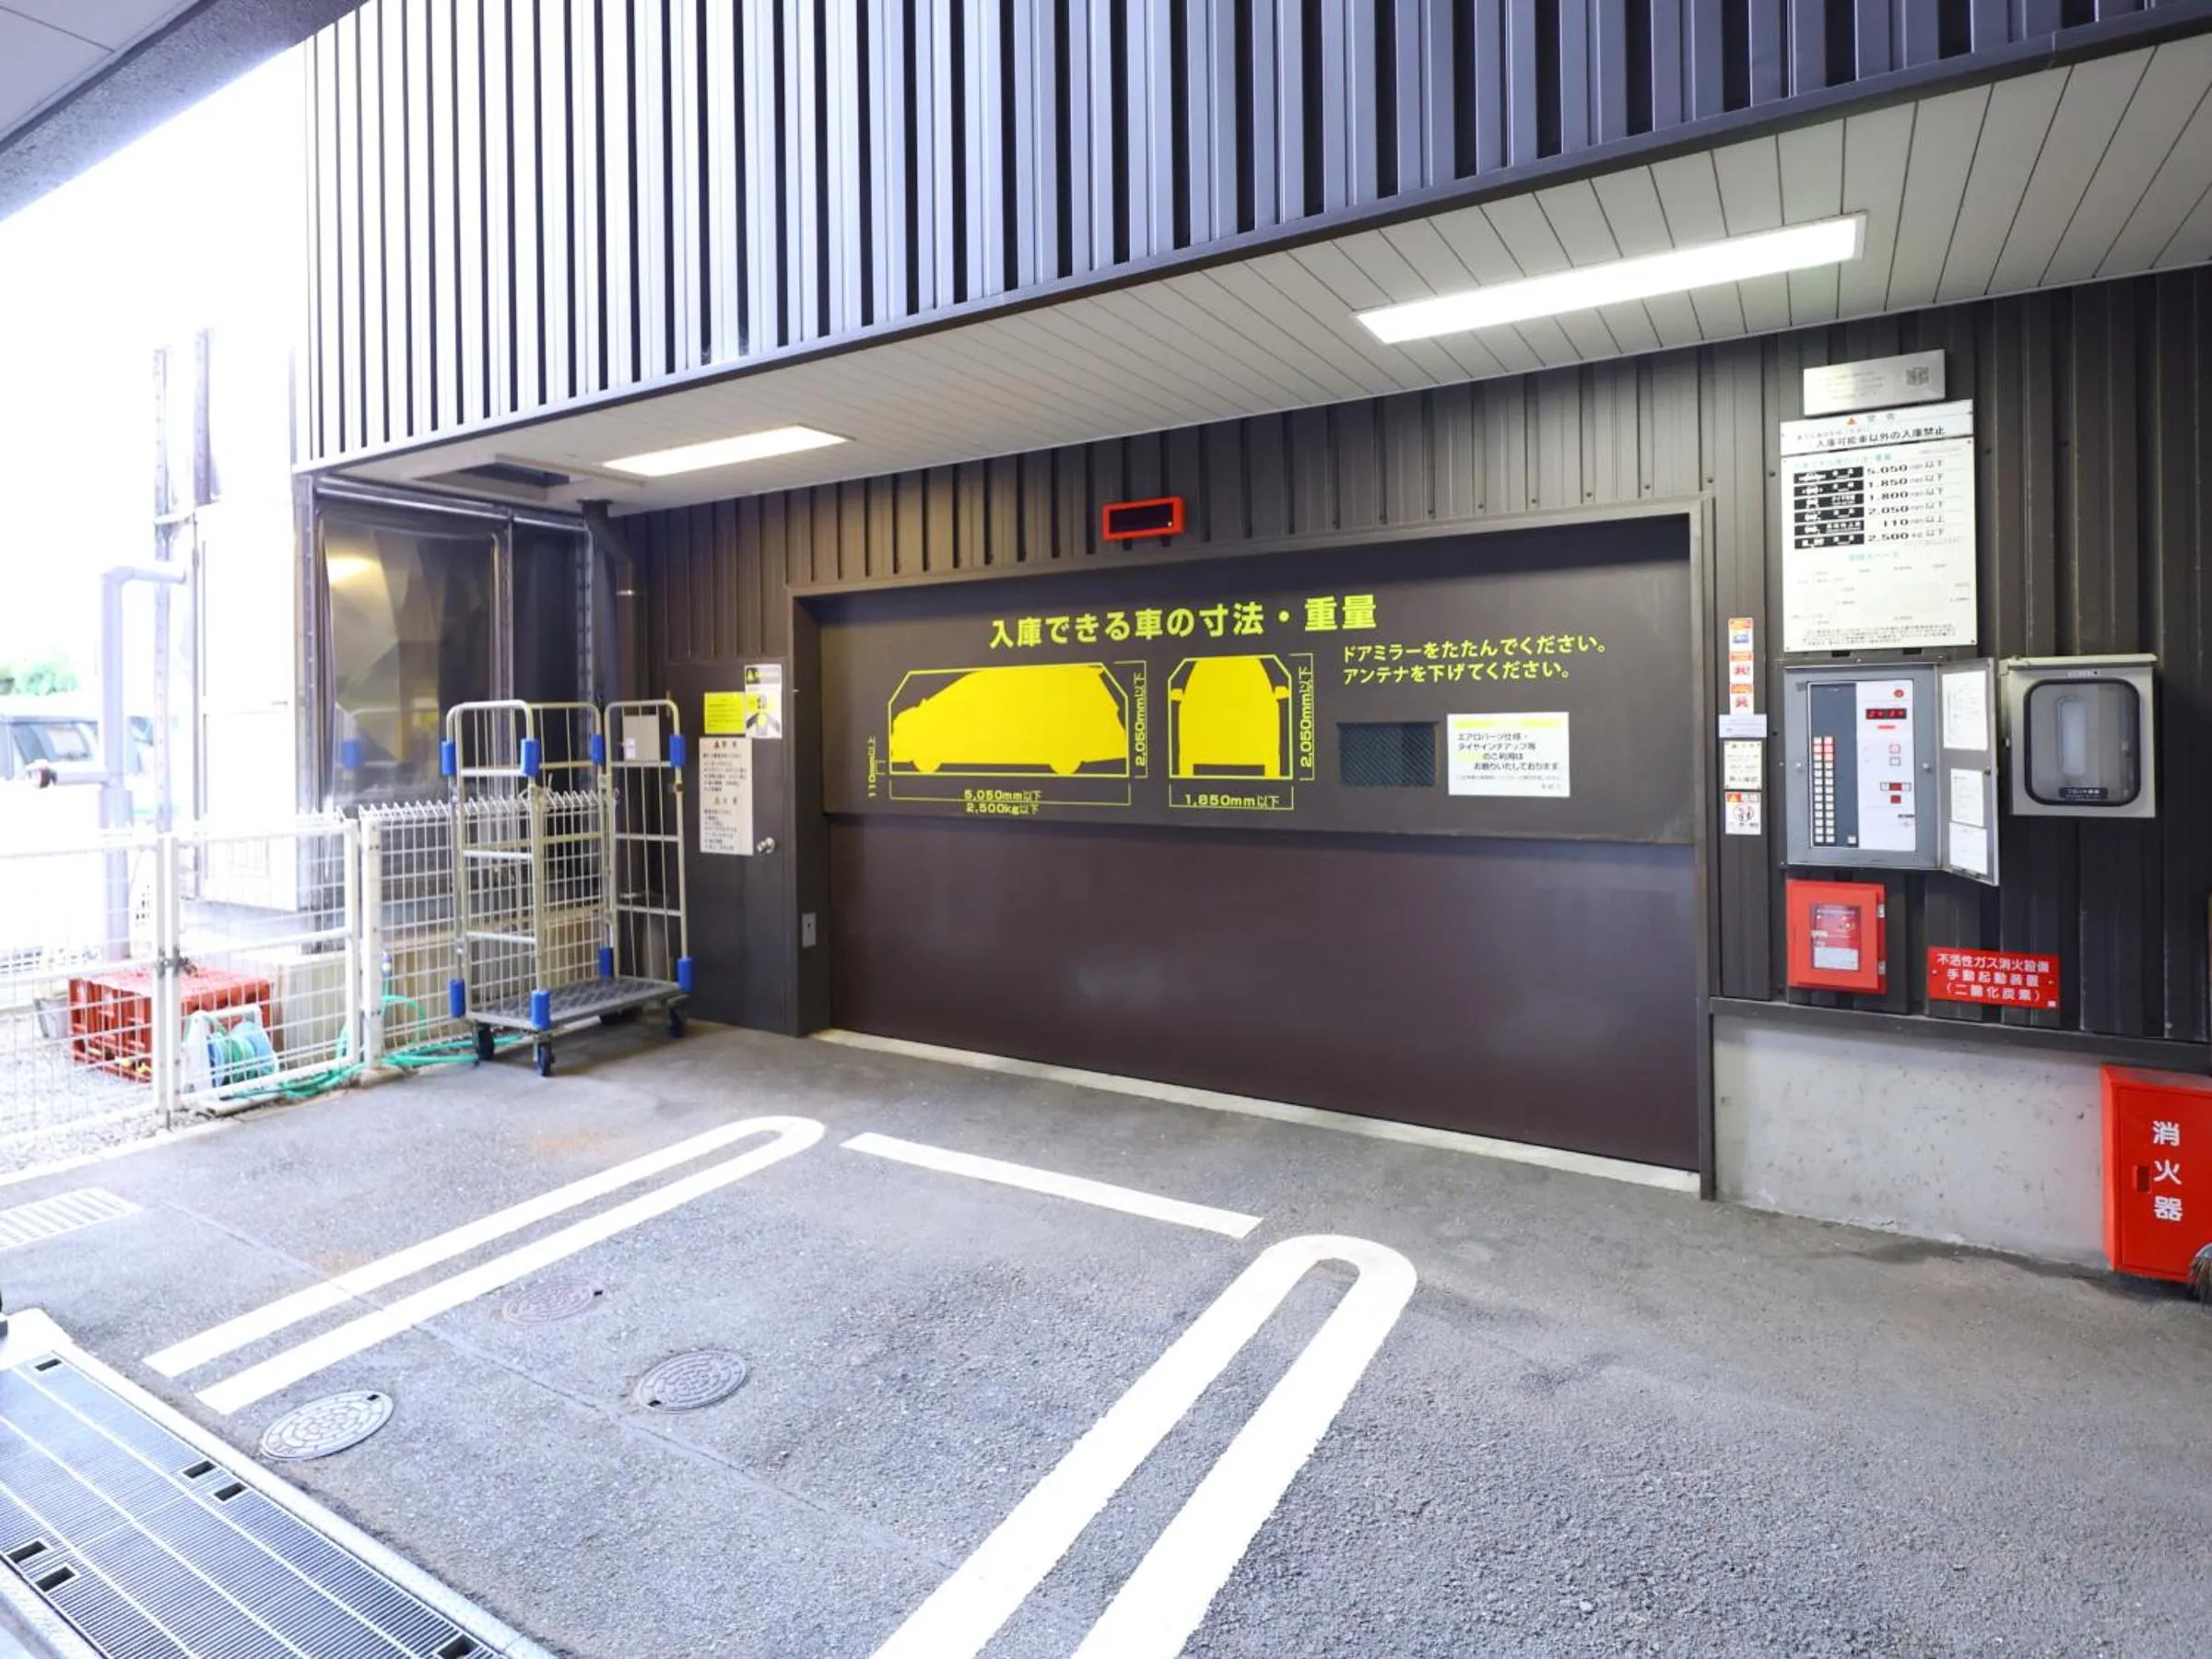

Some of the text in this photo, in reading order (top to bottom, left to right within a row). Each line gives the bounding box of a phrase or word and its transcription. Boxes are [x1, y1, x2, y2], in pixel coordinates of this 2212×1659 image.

[989, 594, 1377, 648] 入庫できる車の寸法・重量
[1344, 635, 1606, 664] ドアミラーをたたんでください。
[1343, 660, 1569, 686] アンテナを下げてください。
[1134, 672, 1146, 767] 2,050mm以下
[1299, 666, 1312, 768] 2,050mm以下
[1185, 794, 1280, 809] 1,850mm以下
[1936, 953, 2050, 973] 不活性ガス消火設備
[1947, 968, 2040, 987] 手動起動装置
[2152, 1120, 2183, 1222] 消火器
